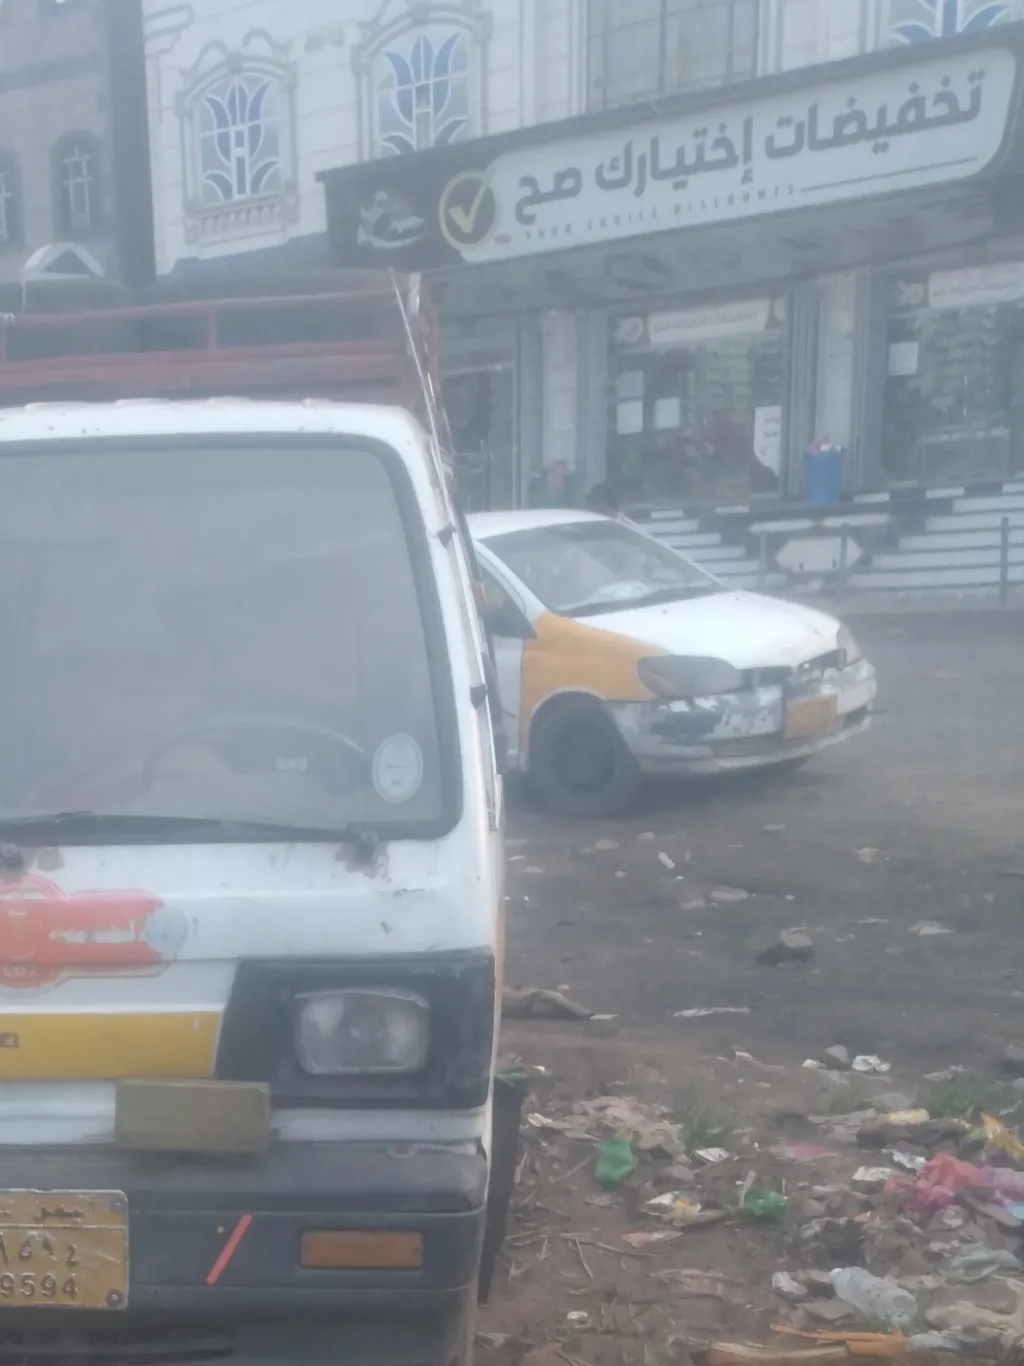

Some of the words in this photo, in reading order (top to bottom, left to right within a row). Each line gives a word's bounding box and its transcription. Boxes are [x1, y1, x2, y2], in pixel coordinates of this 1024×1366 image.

[766, 69, 985, 158] تخفيضات
[514, 163, 582, 225] صح
[594, 115, 755, 198] إختيارك
